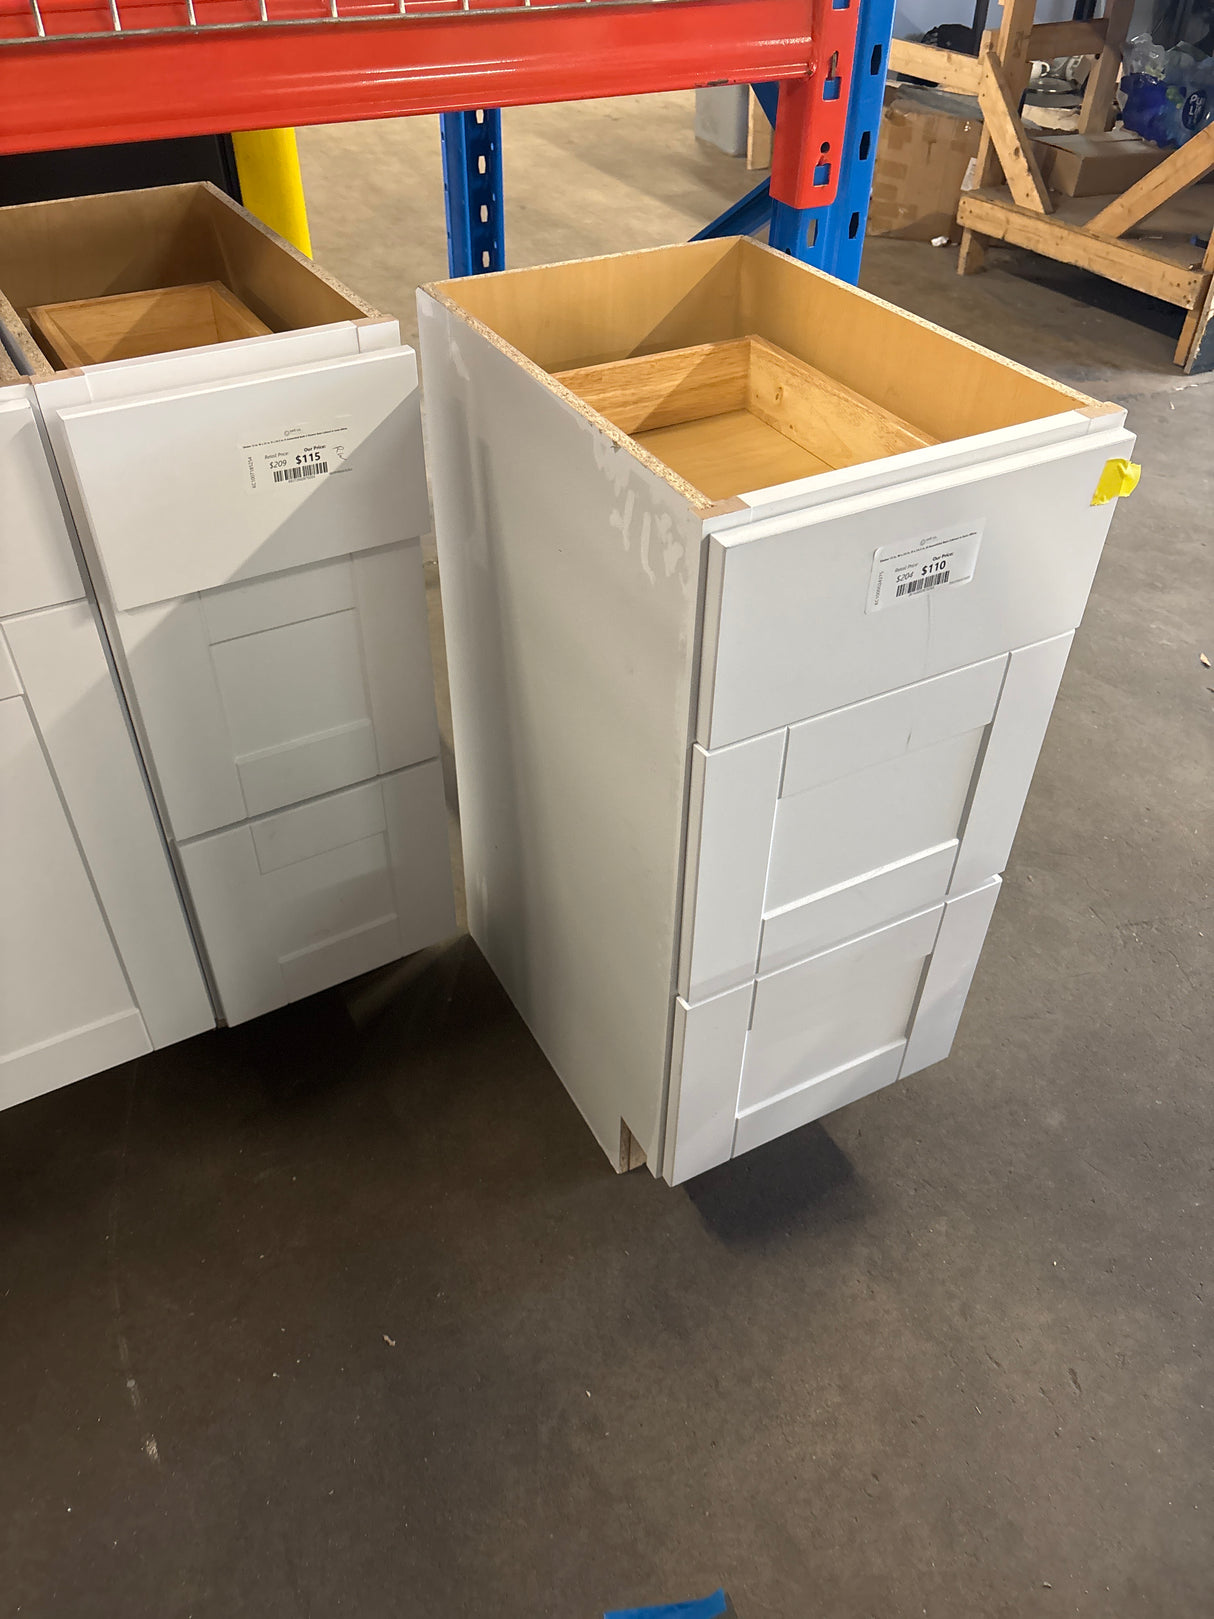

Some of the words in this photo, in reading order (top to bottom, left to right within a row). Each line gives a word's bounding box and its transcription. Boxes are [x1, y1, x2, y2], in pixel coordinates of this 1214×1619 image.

[269, 459, 287, 469] $209
[295, 451, 321, 465] $115
[921, 560, 946, 576] $110
[896, 571, 914, 583] $204
